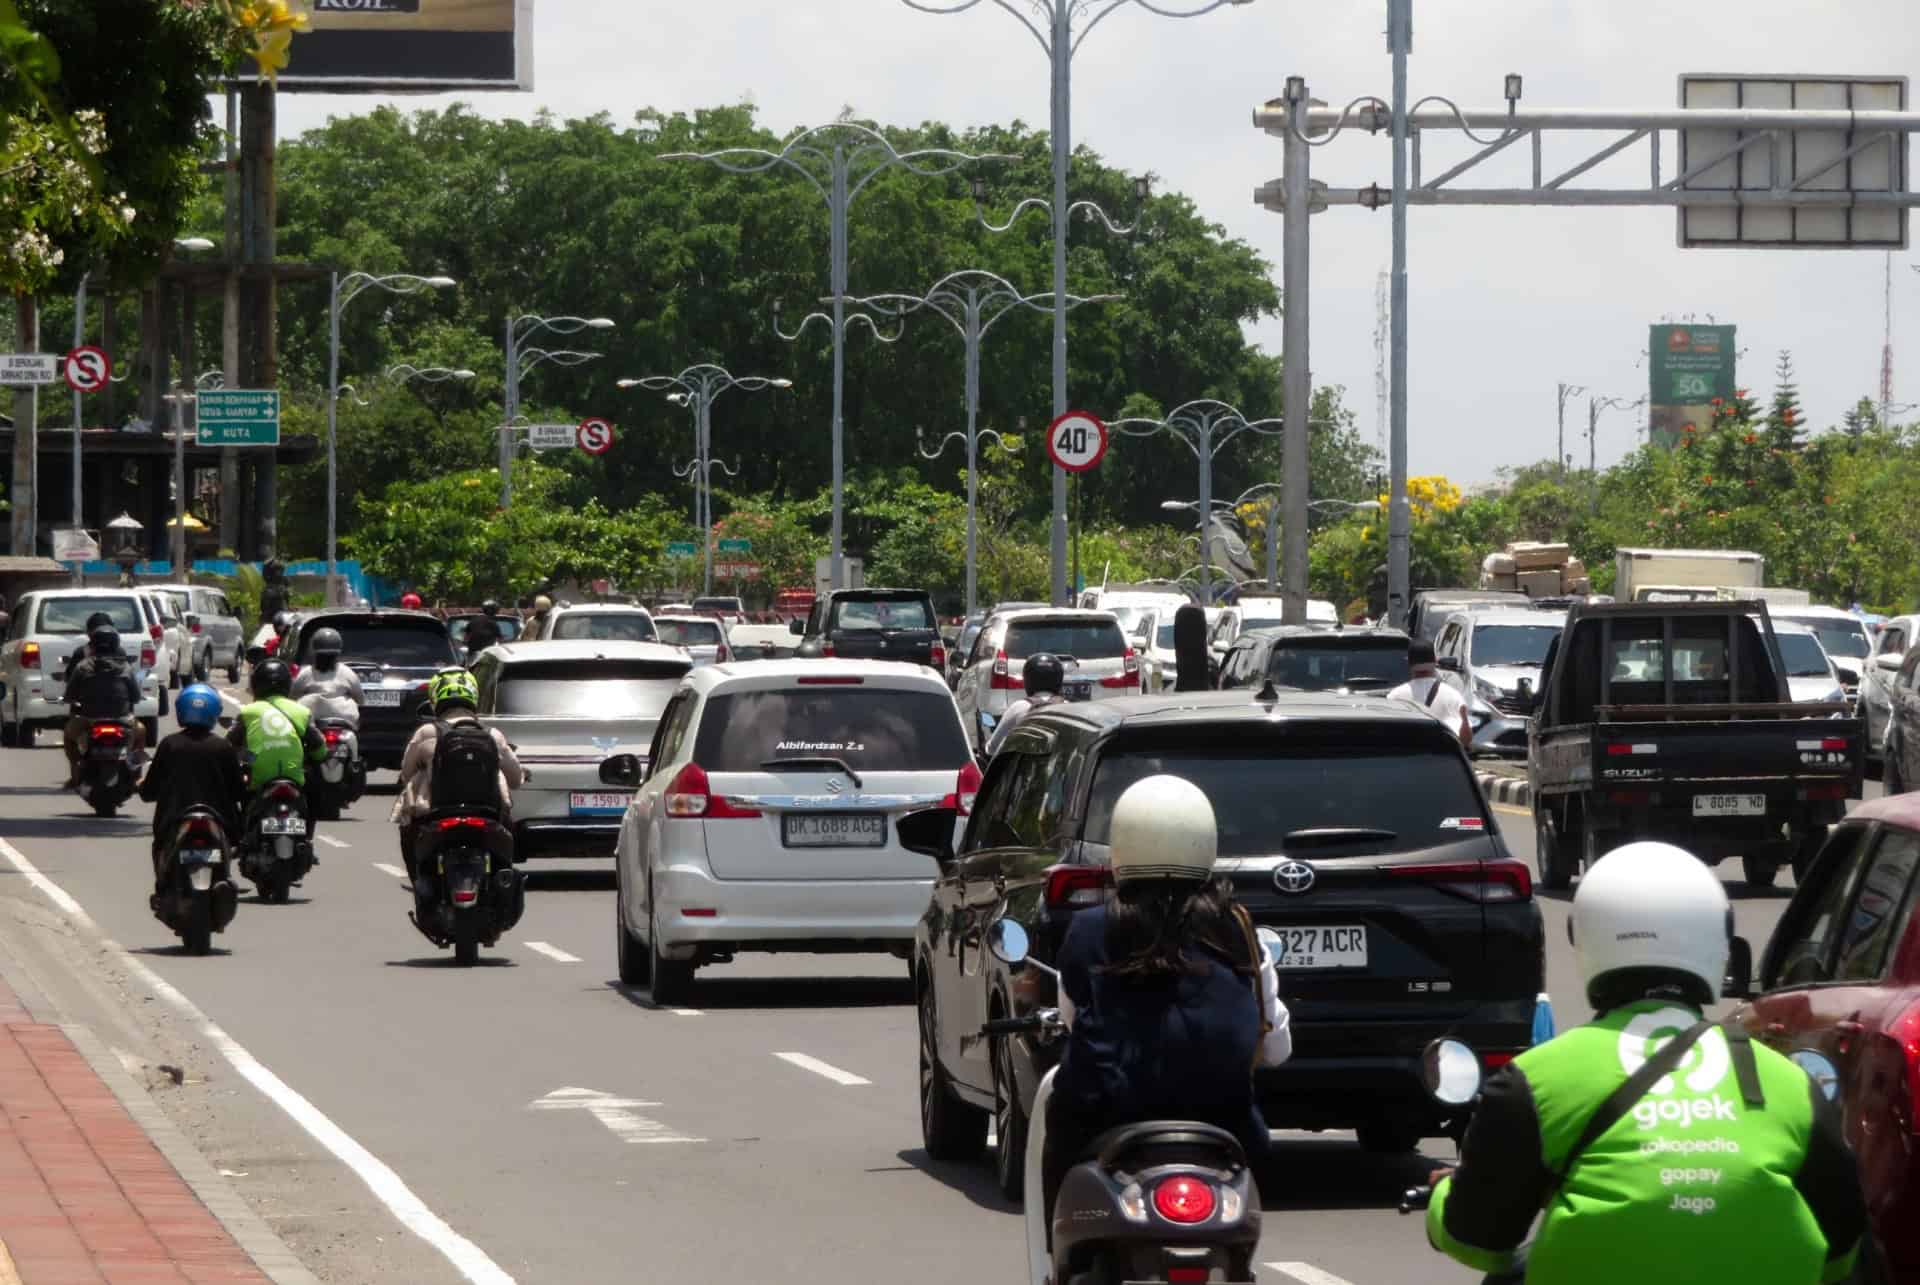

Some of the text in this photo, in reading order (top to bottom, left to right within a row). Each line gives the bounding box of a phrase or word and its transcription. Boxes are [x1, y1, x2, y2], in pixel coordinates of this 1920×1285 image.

[1057, 428, 1087, 454] 40
[1322, 929, 1363, 953] ACR
[1631, 1093, 1737, 1131] gojek
[1660, 1167, 1721, 1187] gopay
[1669, 1193, 1716, 1215] Jago
